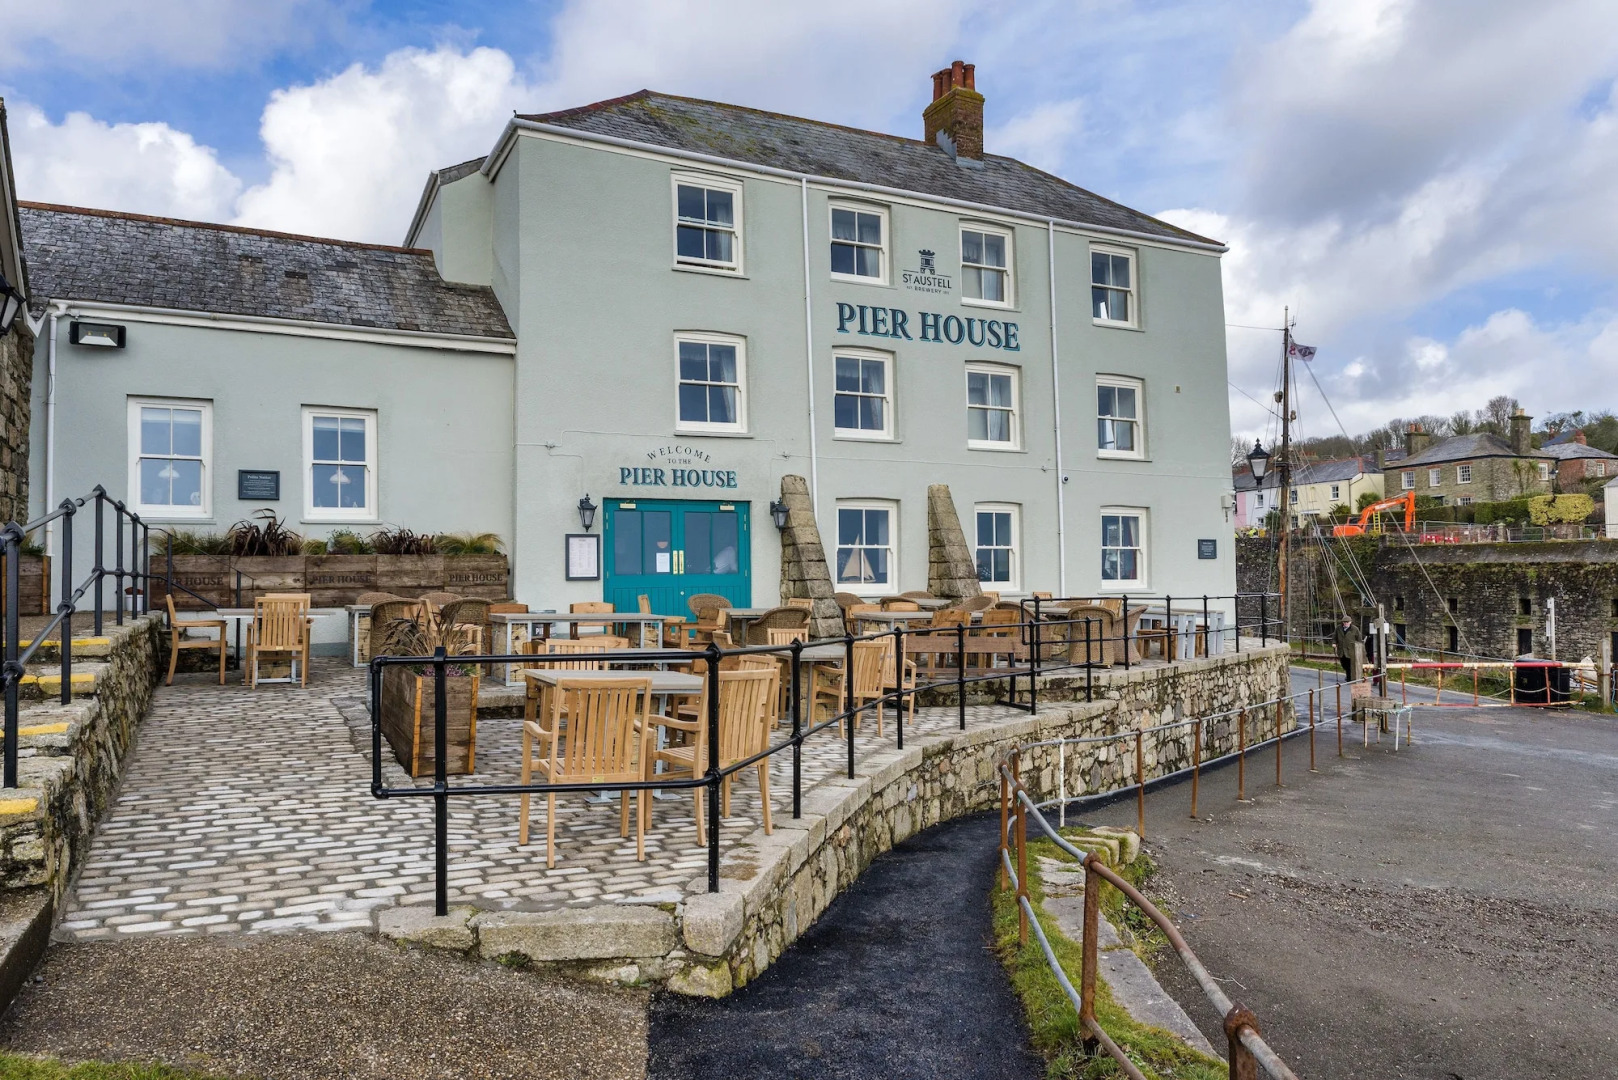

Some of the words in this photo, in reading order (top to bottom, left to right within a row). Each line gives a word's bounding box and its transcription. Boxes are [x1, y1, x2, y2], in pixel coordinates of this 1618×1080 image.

[913, 275, 952, 289] AUSTELL
[914, 286, 942, 294] BREWERY
[836, 302, 913, 341] PIER
[919, 311, 1020, 352] HOUSE
[647, 445, 711, 463] WELCOME
[619, 466, 668, 487] PIER
[671, 468, 738, 489] HOUSE
[185, 576, 224, 586] HOUSE
[336, 574, 372, 584] HOUSE
[449, 573, 471, 583] PIER
[472, 573, 504, 582] HOUSE
